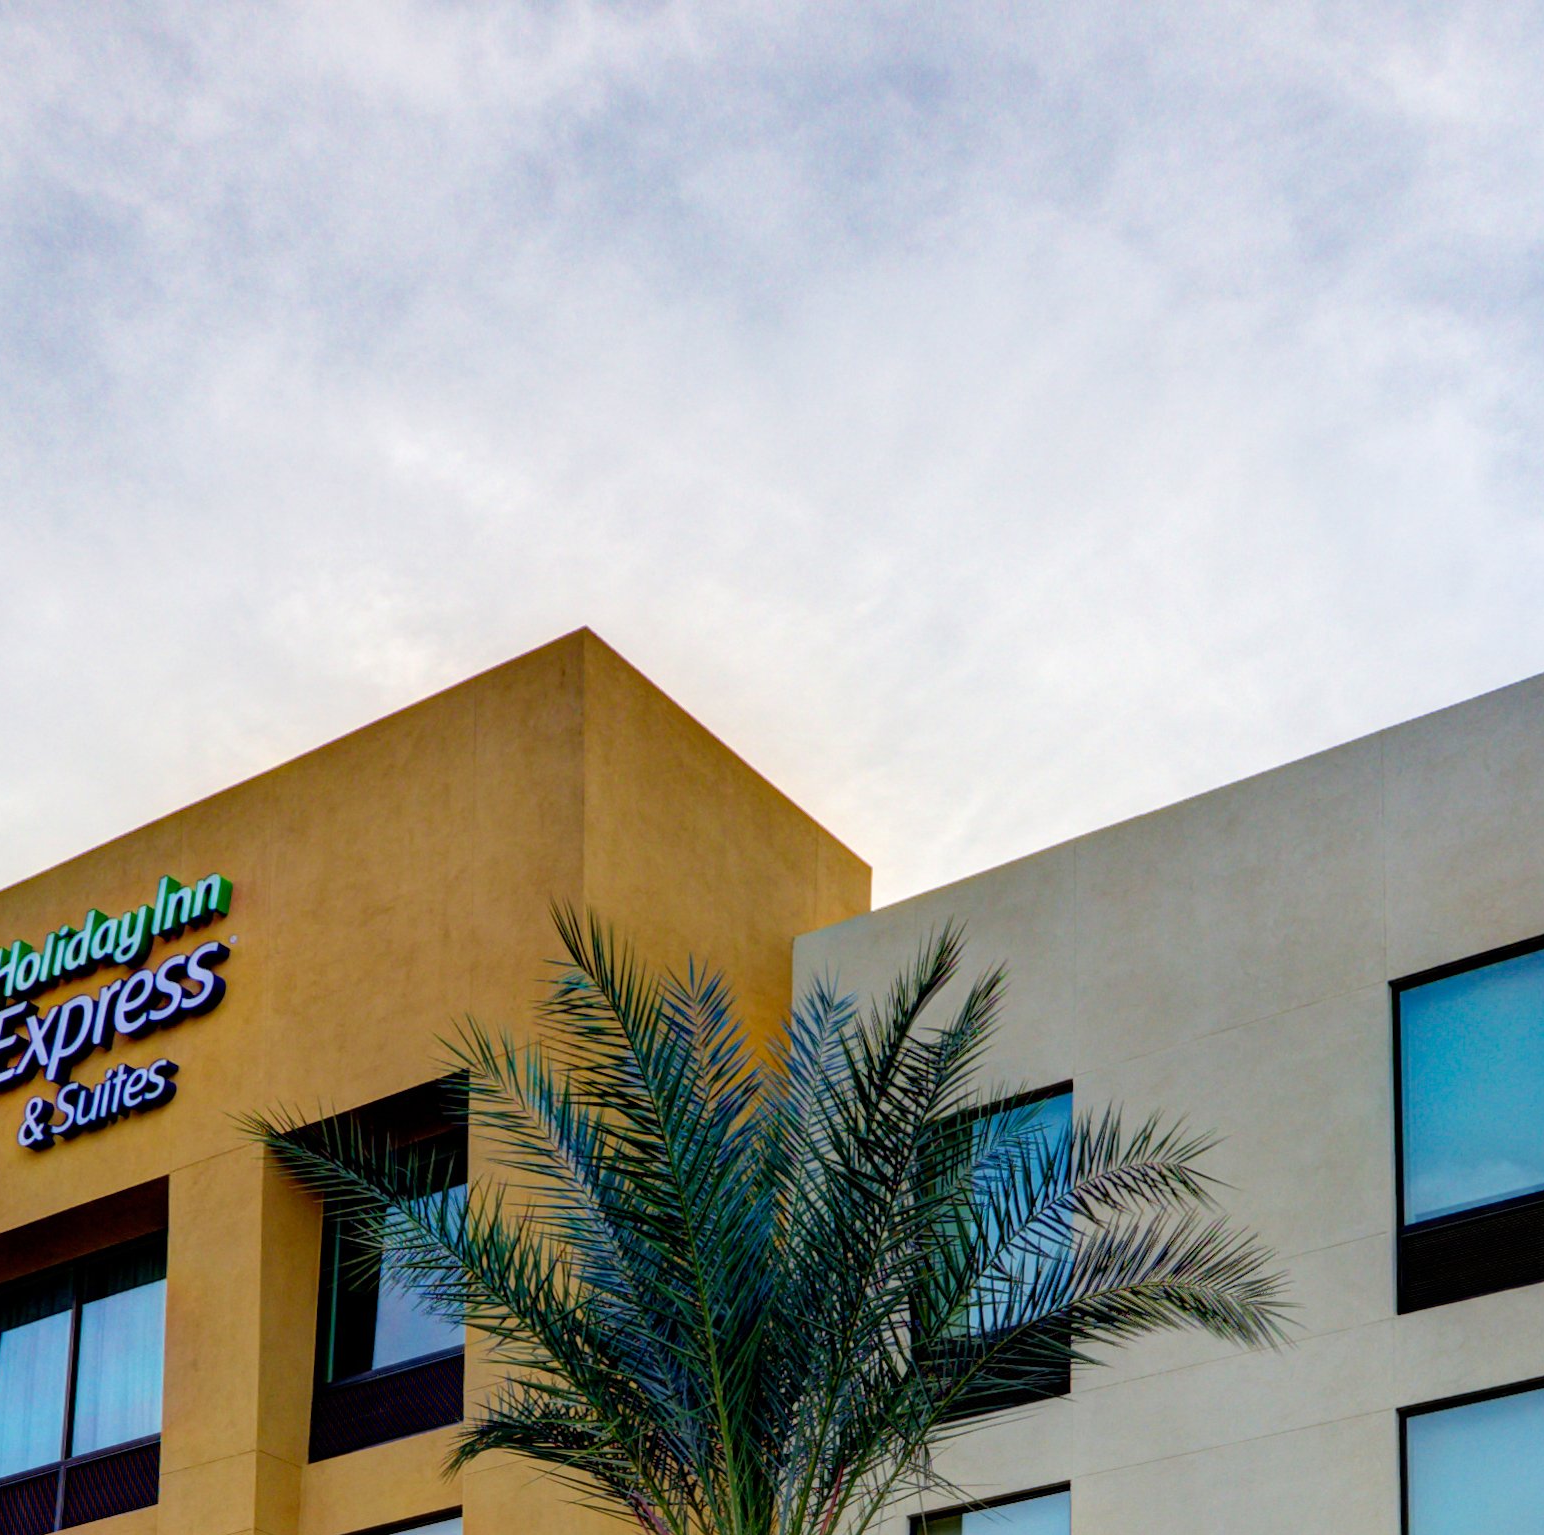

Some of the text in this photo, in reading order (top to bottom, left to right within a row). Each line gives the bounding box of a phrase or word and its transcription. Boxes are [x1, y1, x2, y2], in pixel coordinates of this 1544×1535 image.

[151, 872, 230, 940] Inn
[17, 1058, 177, 1149] & Suites
